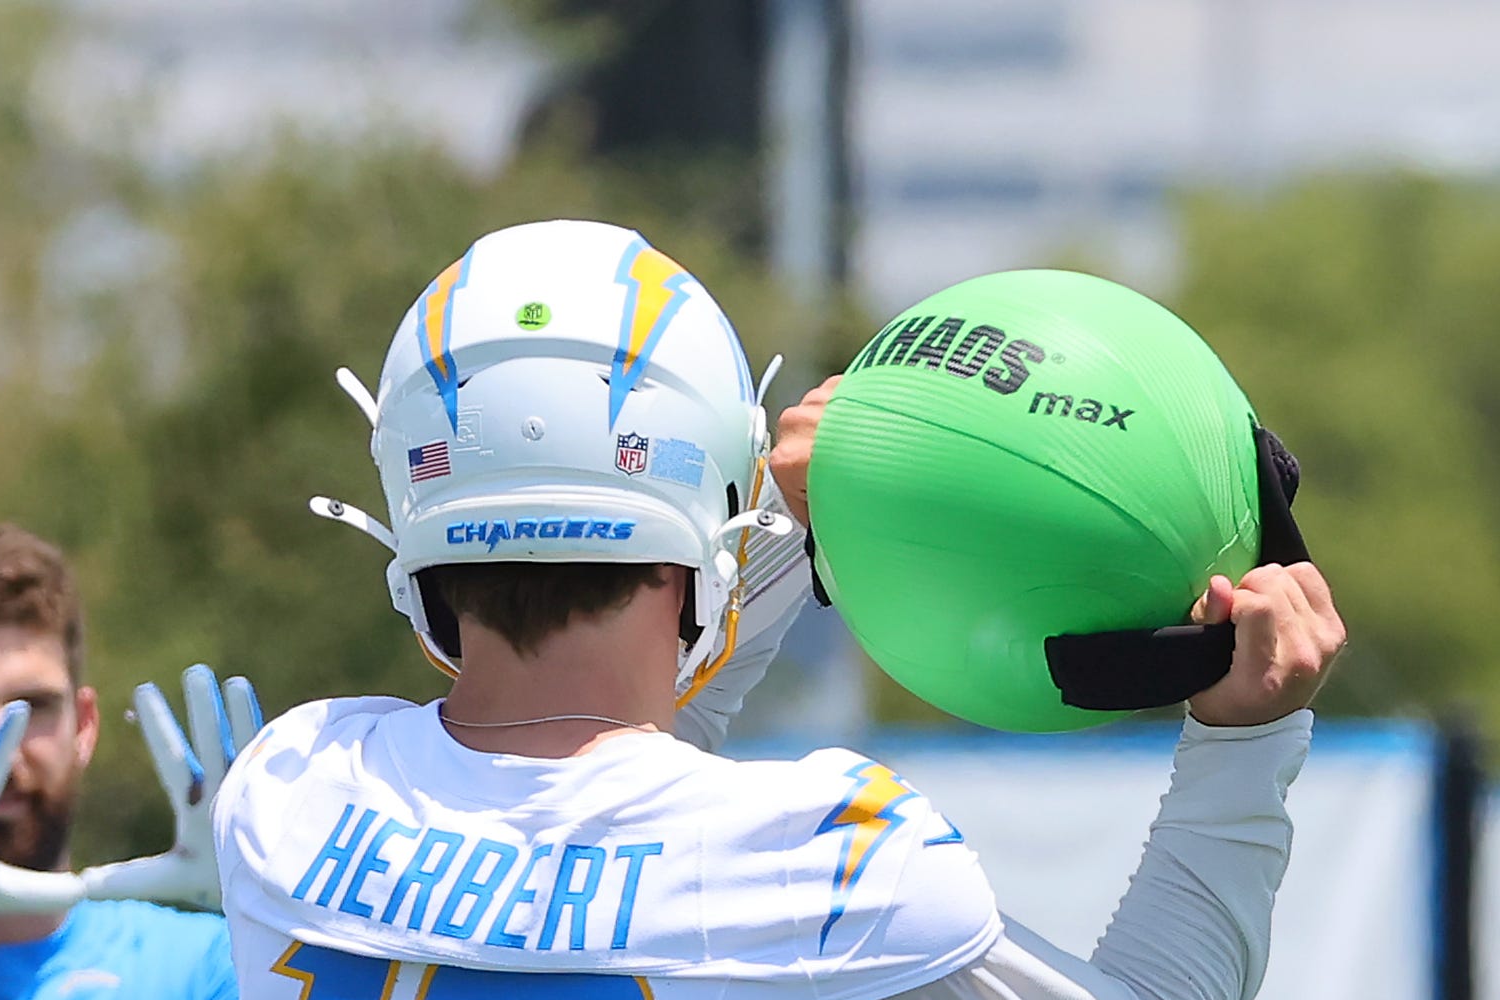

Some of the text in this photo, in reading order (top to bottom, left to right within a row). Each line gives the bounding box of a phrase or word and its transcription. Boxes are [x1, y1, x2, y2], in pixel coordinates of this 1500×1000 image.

[1027, 392, 1135, 431] max
[618, 449, 644, 471] NFL
[447, 517, 636, 553] CHARGERS
[291, 803, 664, 951] HERBERT
